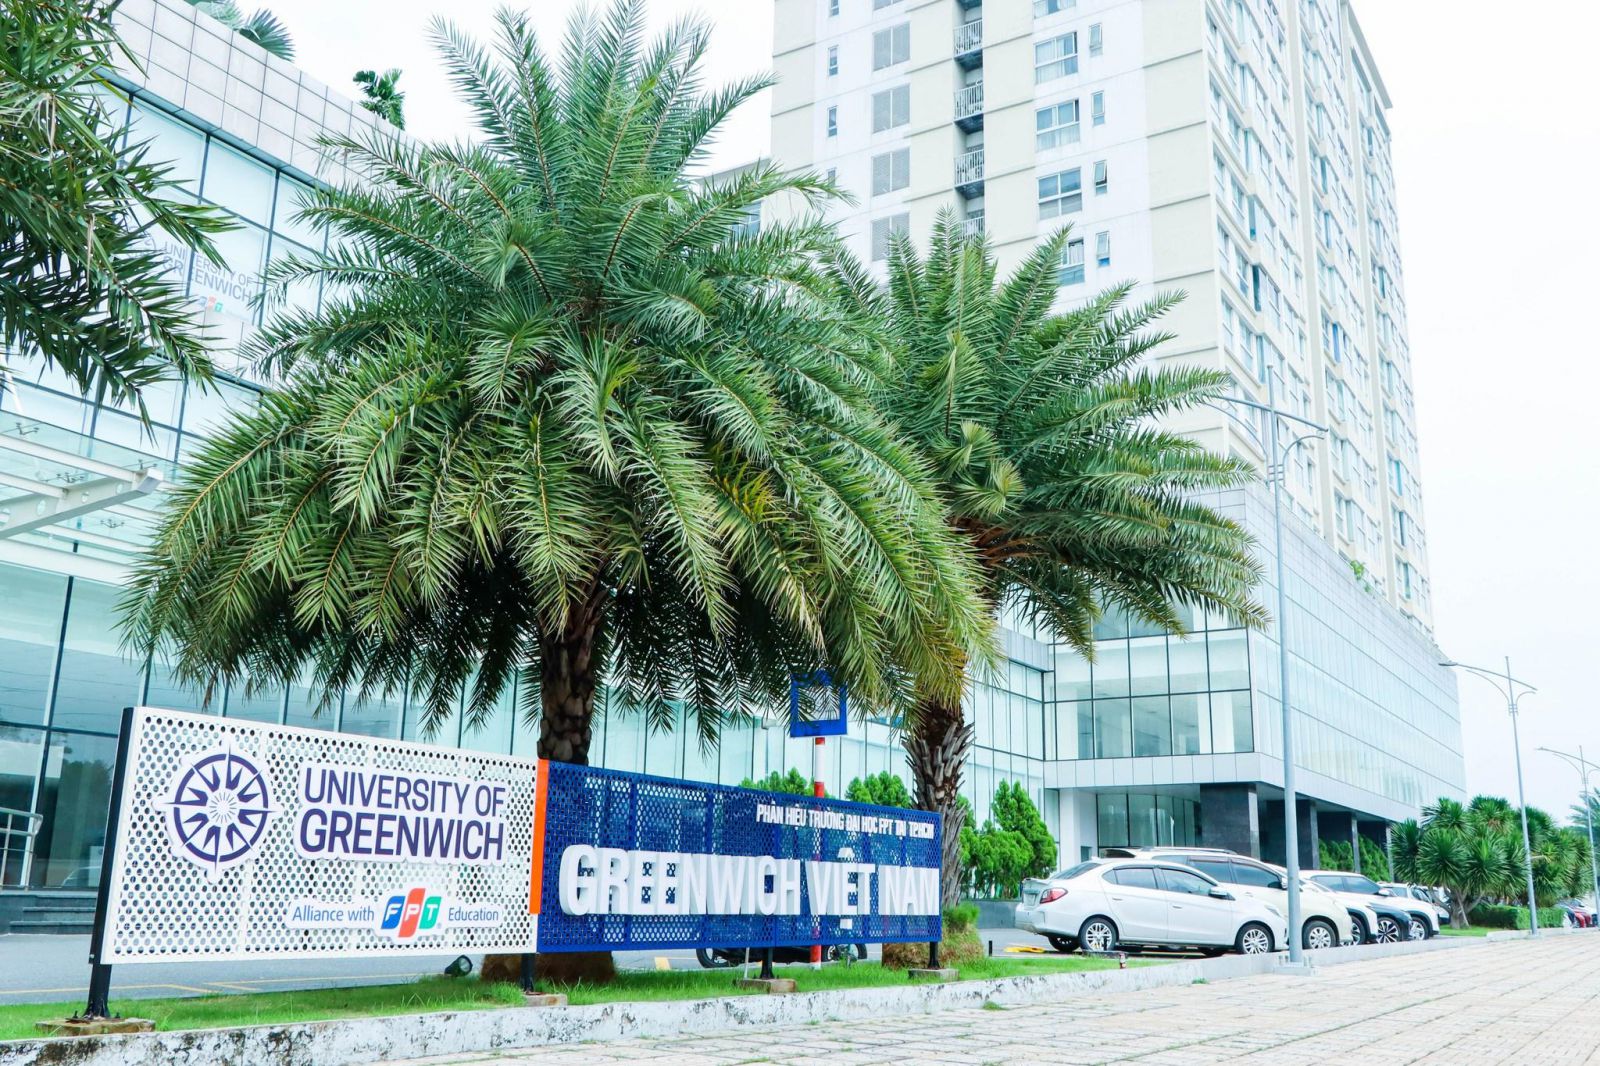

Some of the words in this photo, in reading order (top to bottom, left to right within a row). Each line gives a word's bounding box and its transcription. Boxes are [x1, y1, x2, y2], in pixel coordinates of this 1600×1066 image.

[163, 256, 252, 302] GRENWICH
[165, 241, 236, 281] UNIERSY
[238, 272, 254, 287] OF
[304, 767, 470, 814] UNIVERSITY
[475, 785, 506, 817] OF
[300, 808, 504, 860] GREENWICH
[756, 800, 784, 824] PHÂN
[785, 803, 807, 831] HIỆU
[808, 806, 844, 831] TRƯỜNG
[861, 815, 878, 837] HỌC
[878, 818, 894, 836] FPT
[894, 819, 907, 841] TẠI
[559, 844, 800, 916] GREENWICH
[804, 847, 876, 930] VIỆT
[878, 863, 940, 916] NAM
[292, 905, 344, 922] Alliance
[347, 905, 375, 922] with
[448, 905, 499, 922] Education
